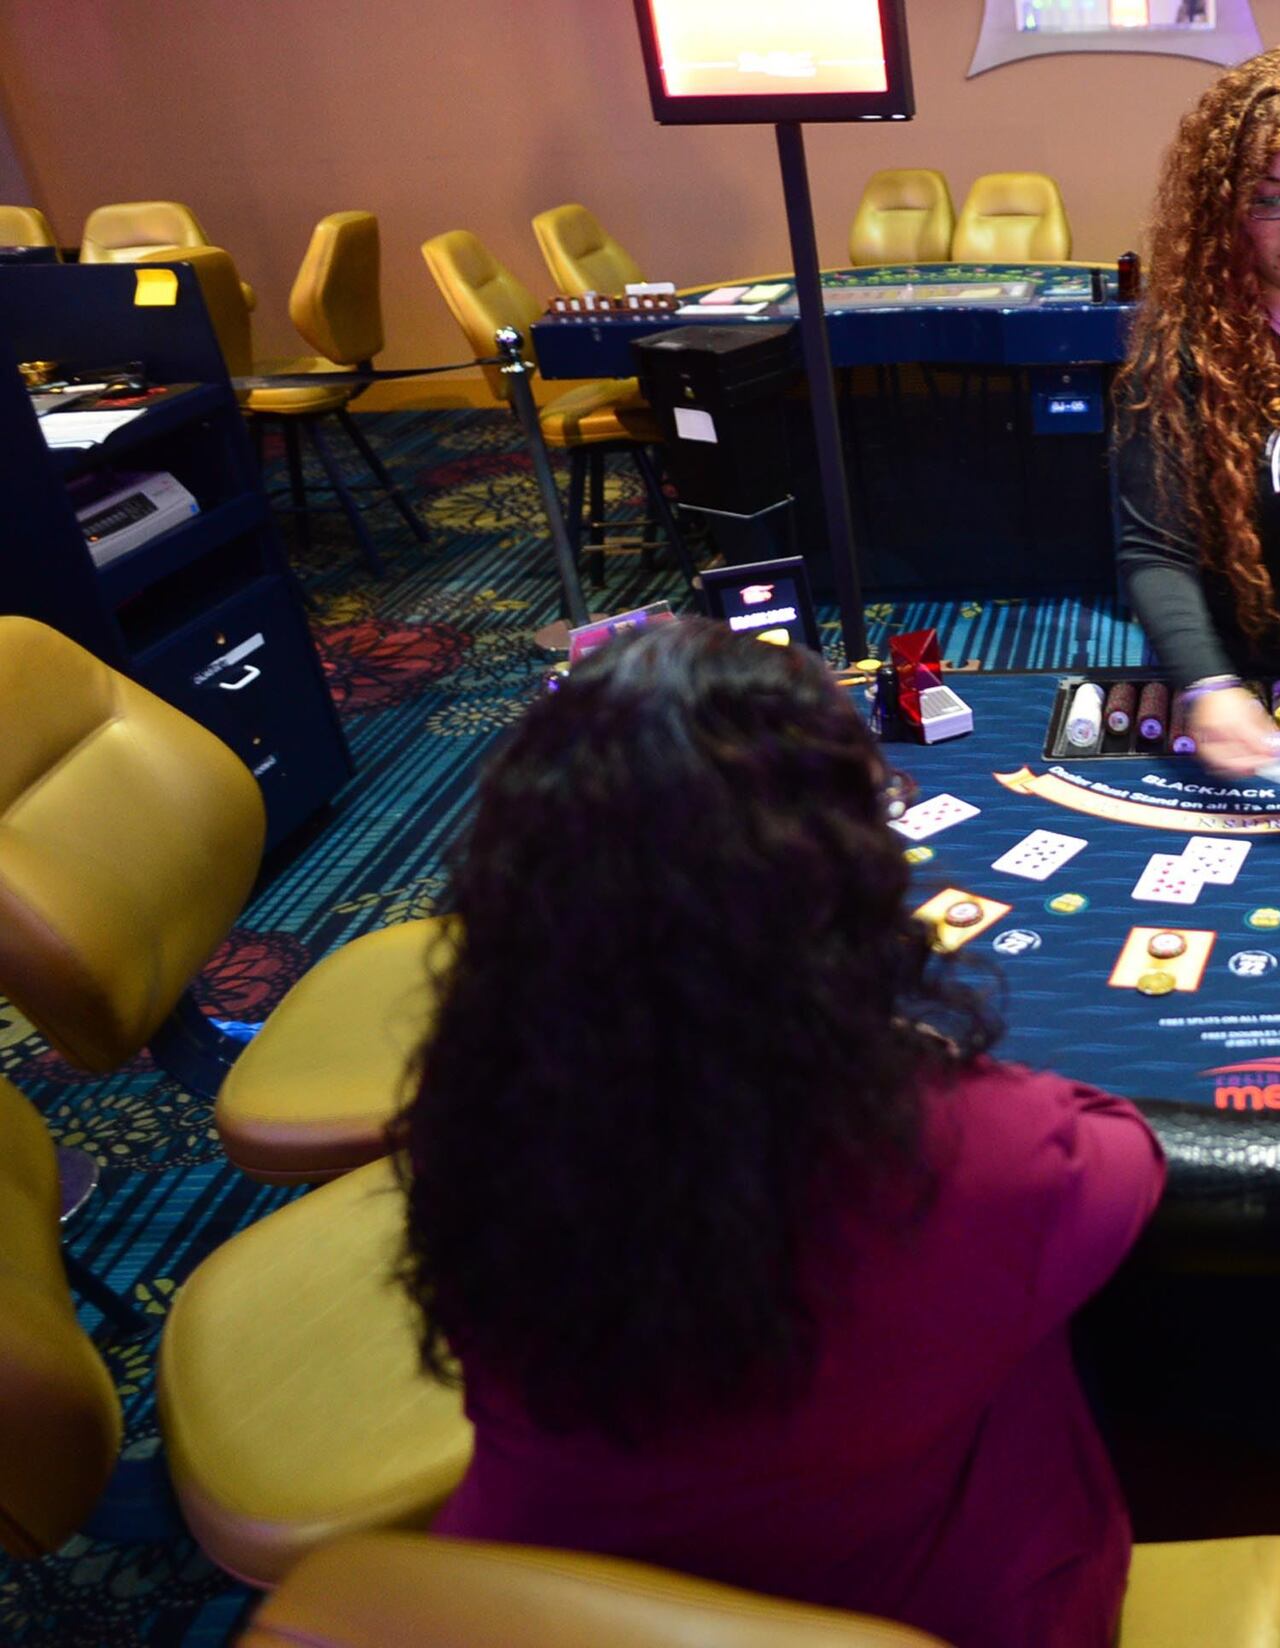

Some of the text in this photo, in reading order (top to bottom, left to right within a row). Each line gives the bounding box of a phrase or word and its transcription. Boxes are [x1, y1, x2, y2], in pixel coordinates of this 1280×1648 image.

[1049, 767, 1092, 785] Dealer
[1090, 783, 1130, 797] Must
[1130, 793, 1178, 807] Stand
[1180, 801, 1204, 810] on
[1206, 802, 1228, 810] all
[1233, 802, 1263, 811] 17s
[1141, 774, 1276, 798] BLACKJACK
